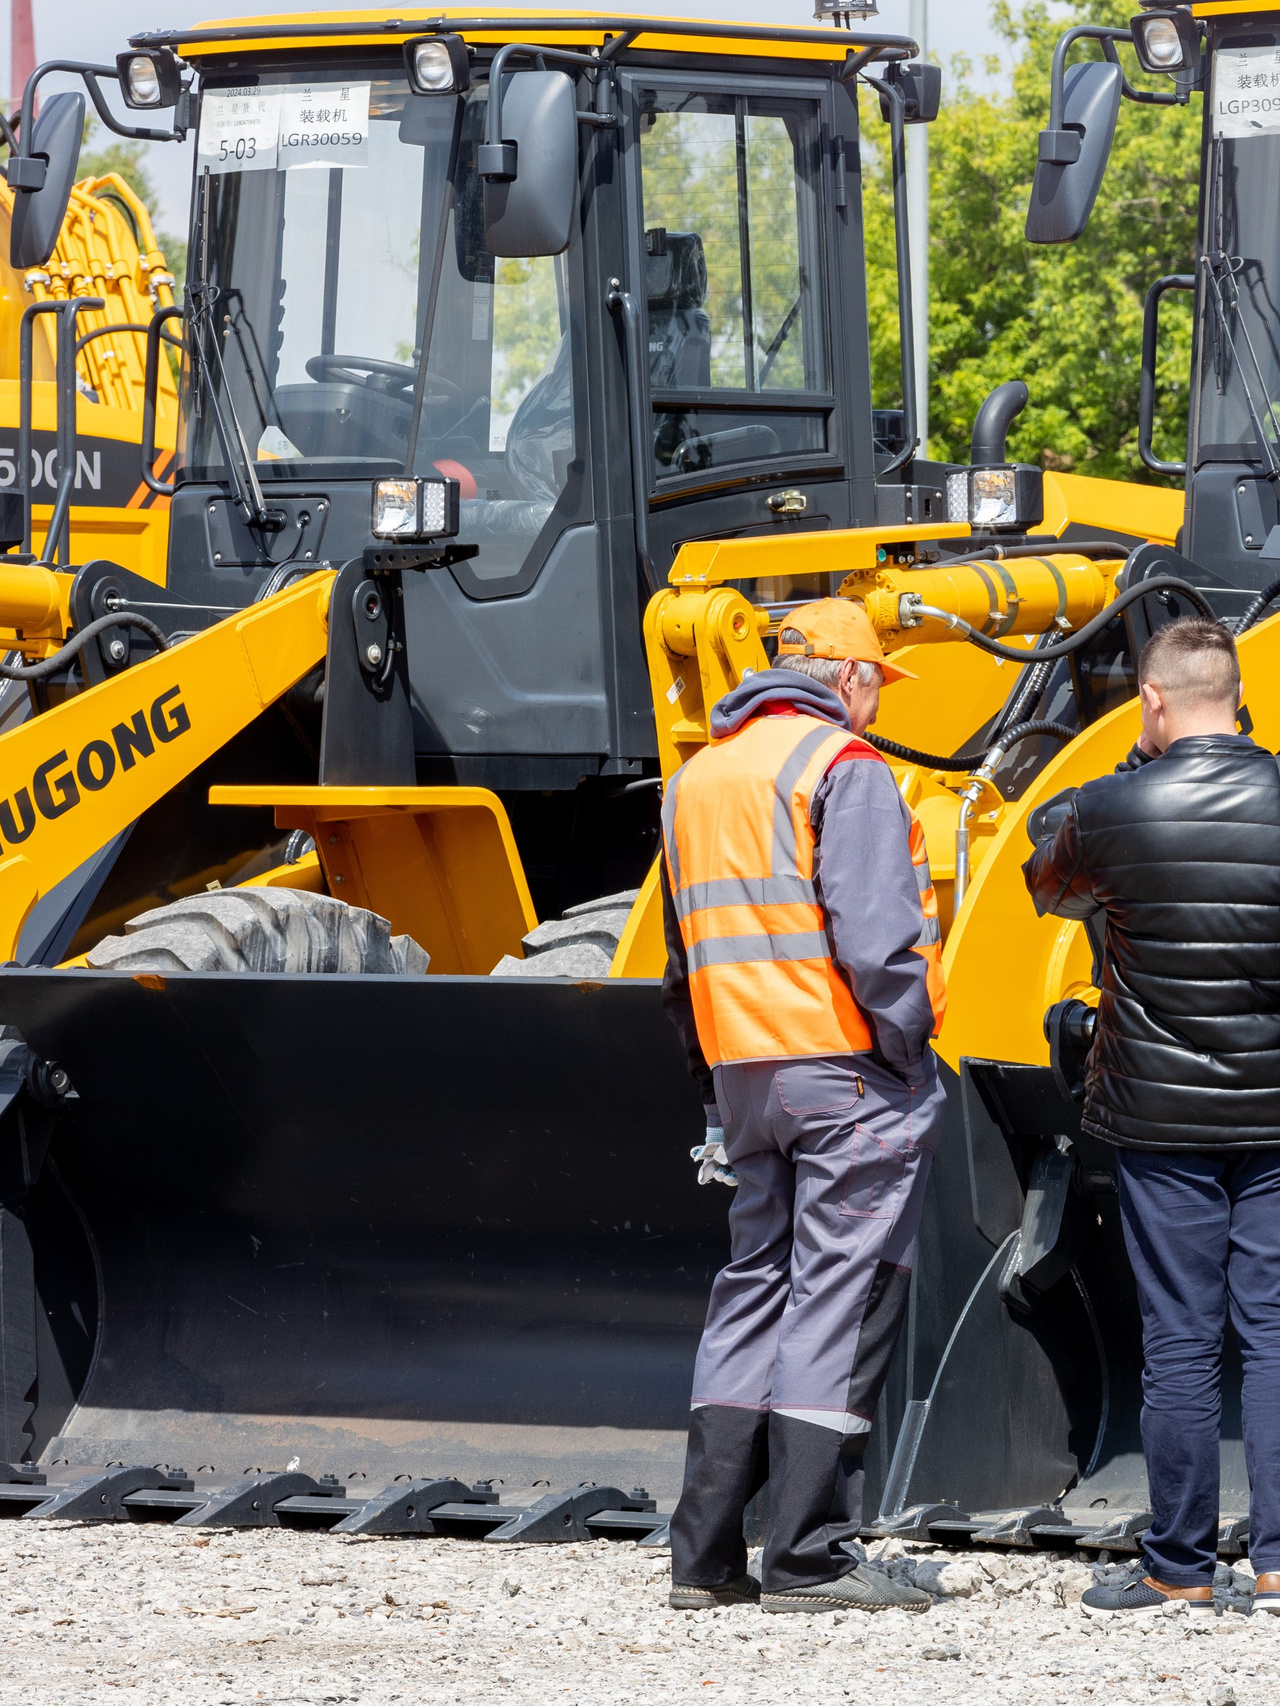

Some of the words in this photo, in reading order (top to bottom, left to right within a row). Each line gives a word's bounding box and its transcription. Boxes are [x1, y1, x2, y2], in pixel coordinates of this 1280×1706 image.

[226, 87, 261, 98] 2024.03.29
[299, 108, 348, 123] 装载机
[282, 132, 362, 147] LGR30059
[219, 137, 256, 161] 5-03
